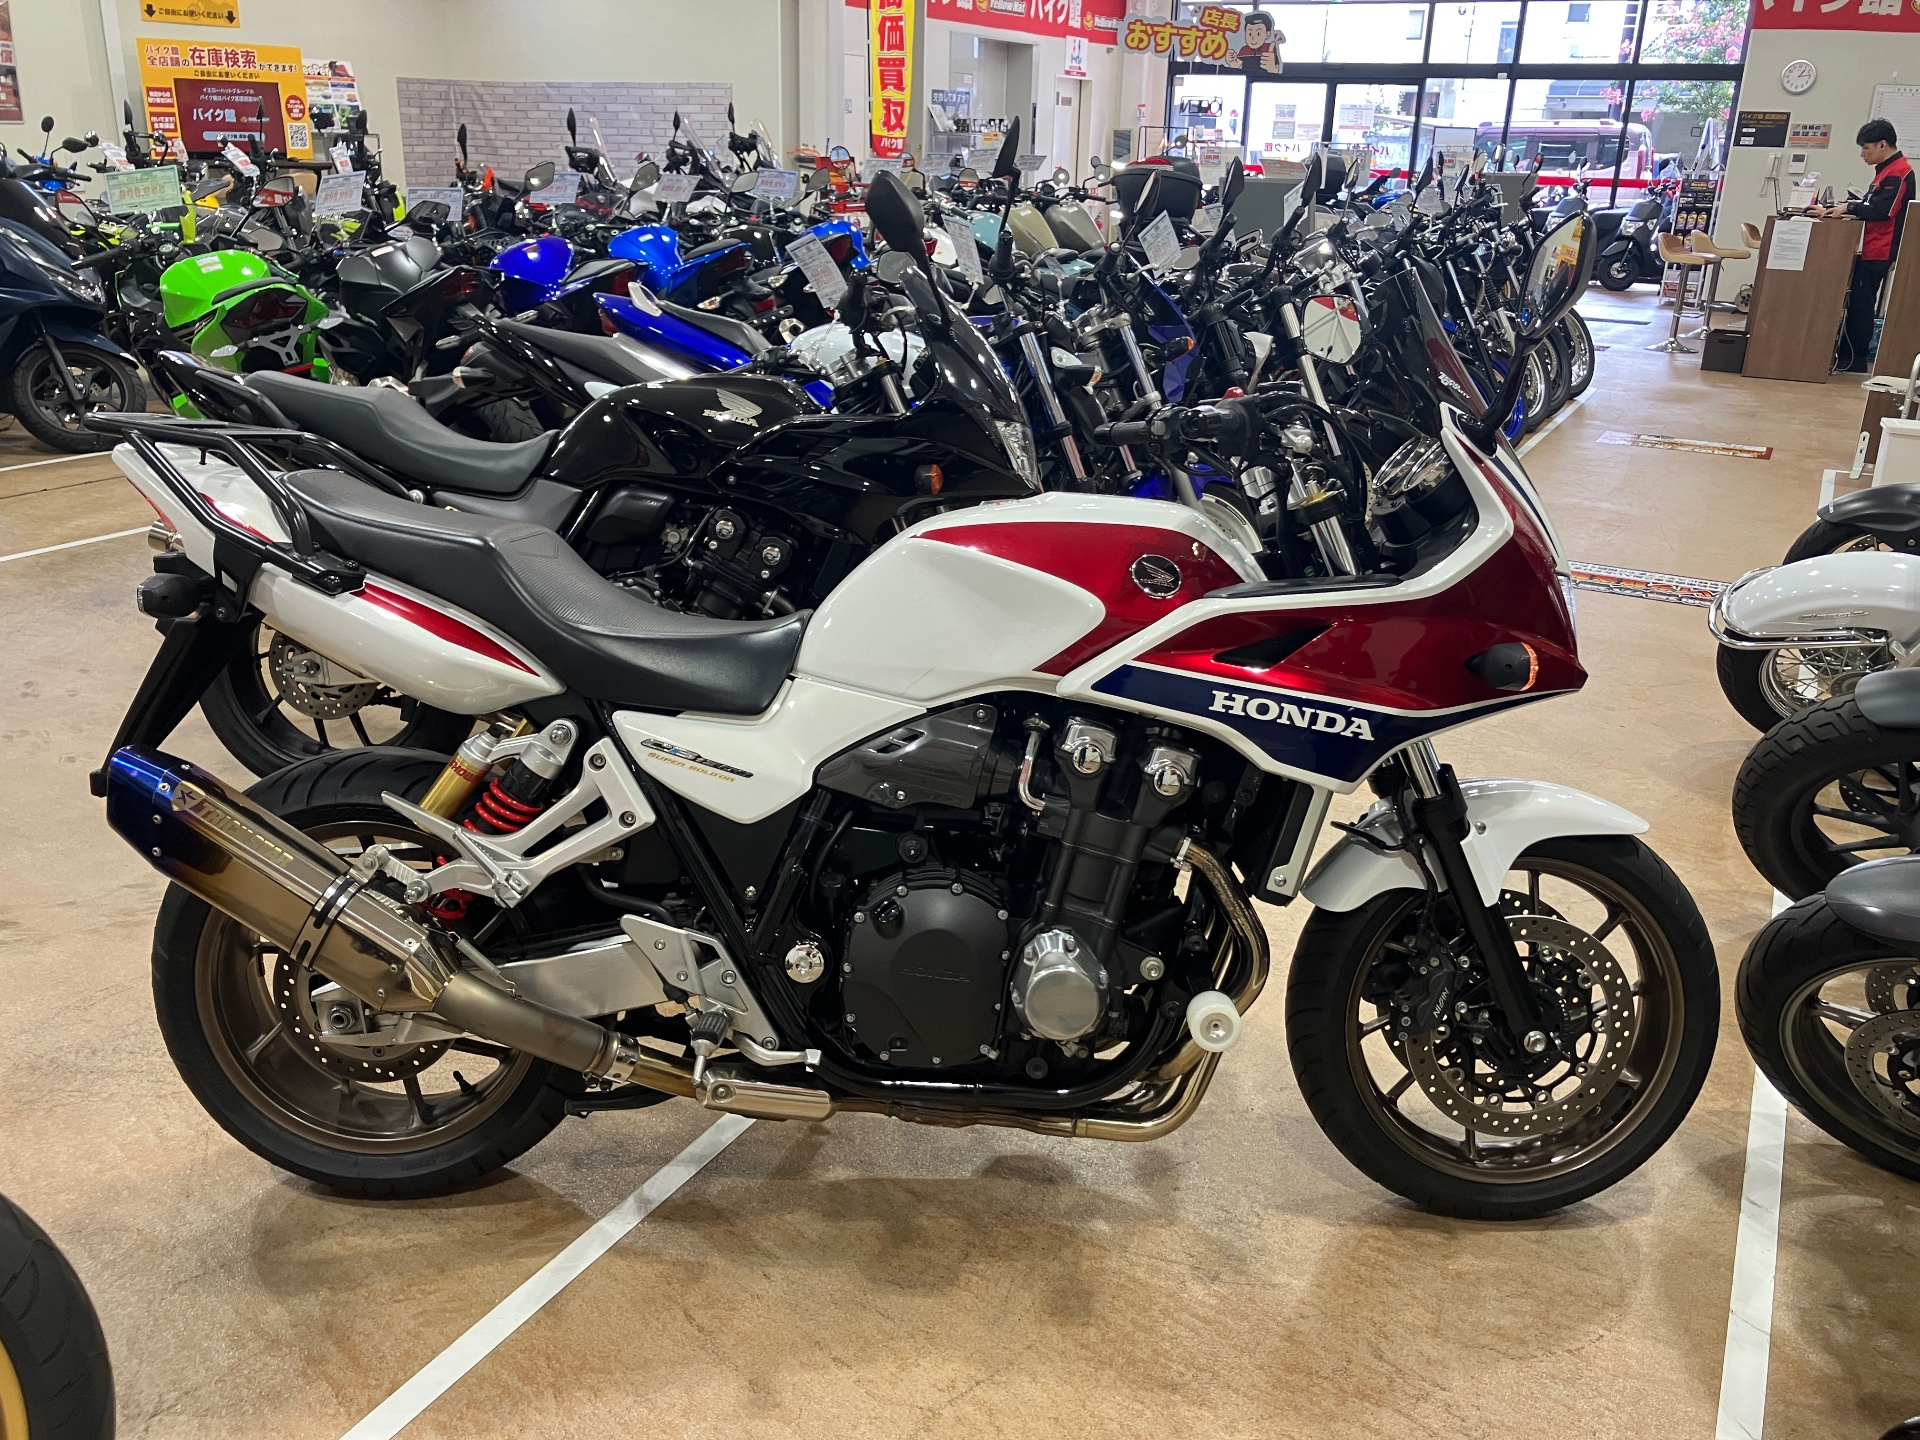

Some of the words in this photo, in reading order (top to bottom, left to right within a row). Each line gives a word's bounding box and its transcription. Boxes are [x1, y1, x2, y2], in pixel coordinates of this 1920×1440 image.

[1203, 8, 1240, 31] 店長
[1125, 21, 1229, 60] おすすめ
[193, 108, 237, 123] バイク館
[1208, 690, 1375, 741] HONDA
[647, 752, 686, 767] SUPER
